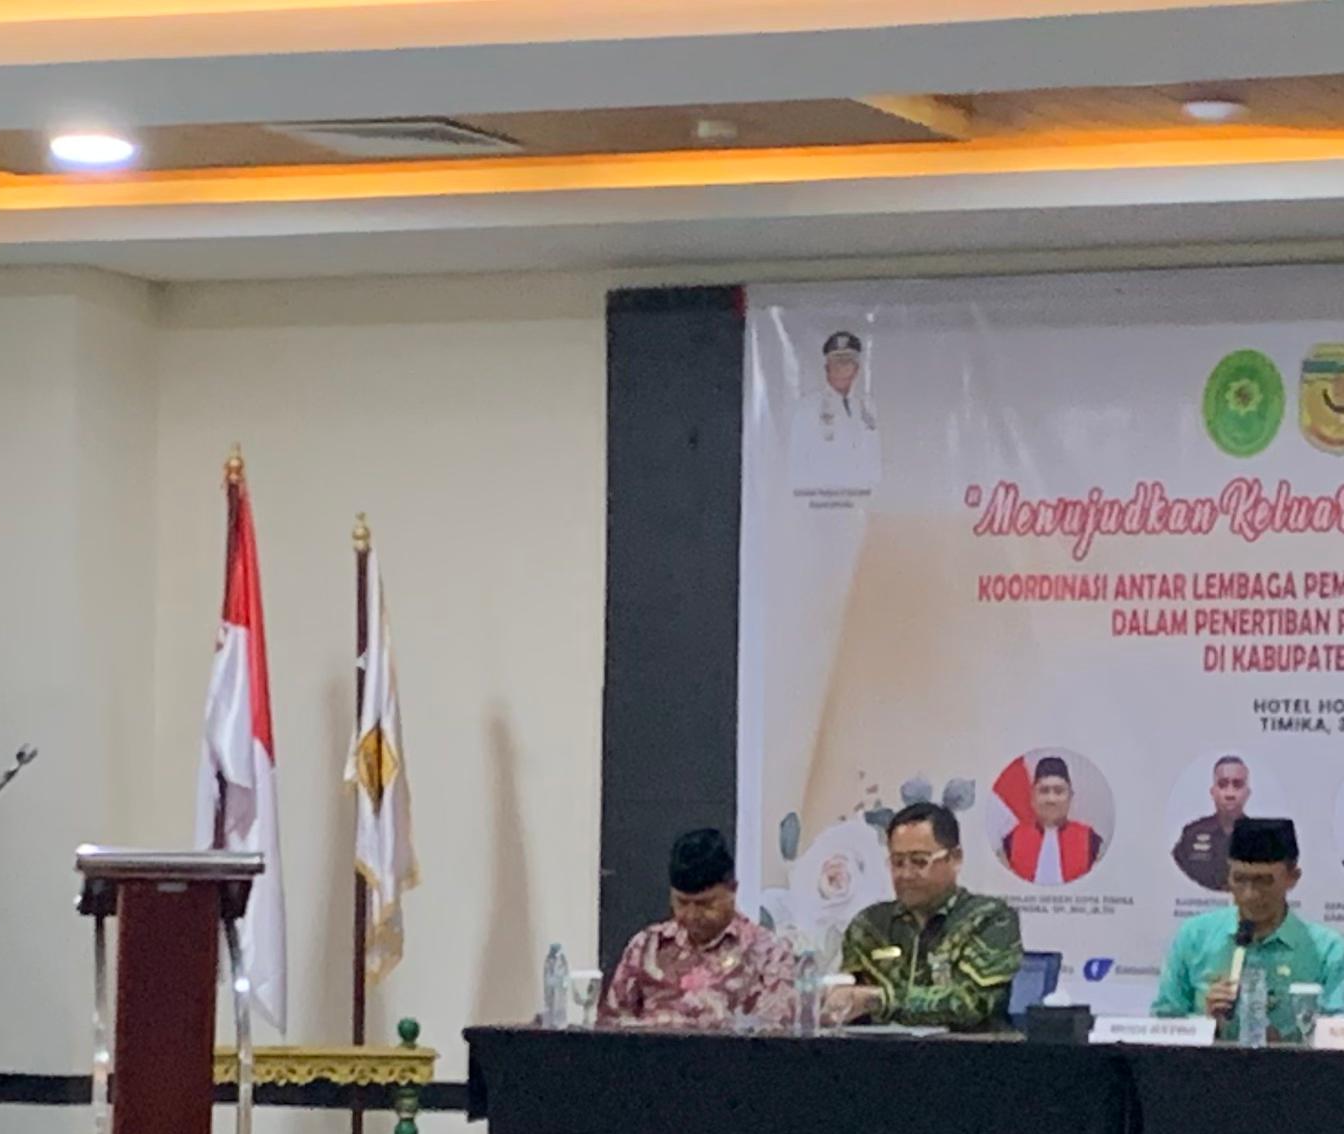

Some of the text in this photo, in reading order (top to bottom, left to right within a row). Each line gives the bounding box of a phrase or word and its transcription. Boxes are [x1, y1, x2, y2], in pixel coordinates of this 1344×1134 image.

[978, 573, 1107, 602] KOORDINASI
[1114, 573, 1186, 601] ANTAR
[1192, 572, 1297, 600] LEMBAGA
[1112, 609, 1188, 637] DALAM
[1195, 608, 1330, 636] PENERTIBAN
[1204, 645, 1225, 672] DI
[1253, 699, 1312, 714] HOTEL
